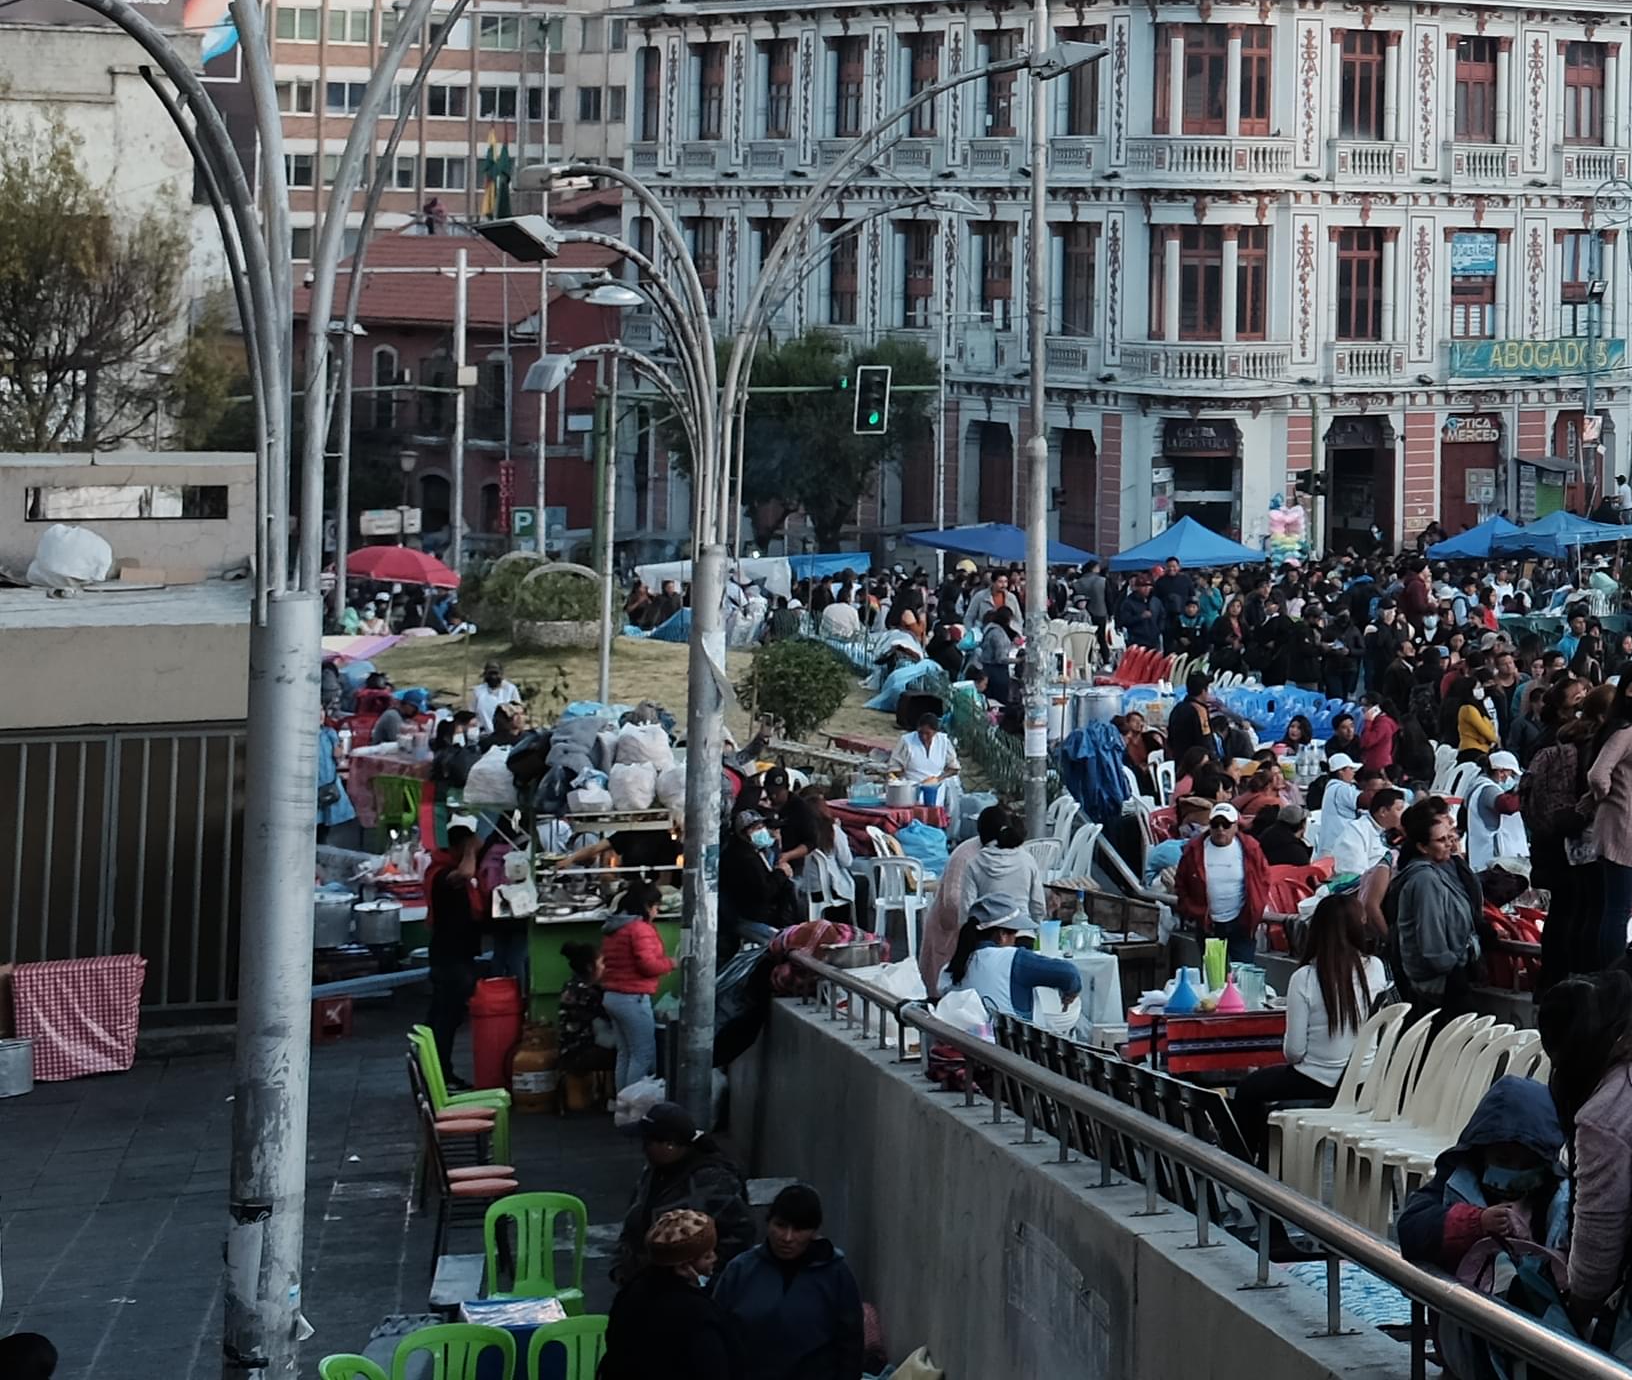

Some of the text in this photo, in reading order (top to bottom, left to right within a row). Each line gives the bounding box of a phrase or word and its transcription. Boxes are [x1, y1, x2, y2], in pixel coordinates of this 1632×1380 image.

[1489, 341, 1608, 369] ABOGADOS
[1446, 429, 1500, 443] MERCED
[514, 511, 533, 535] P
